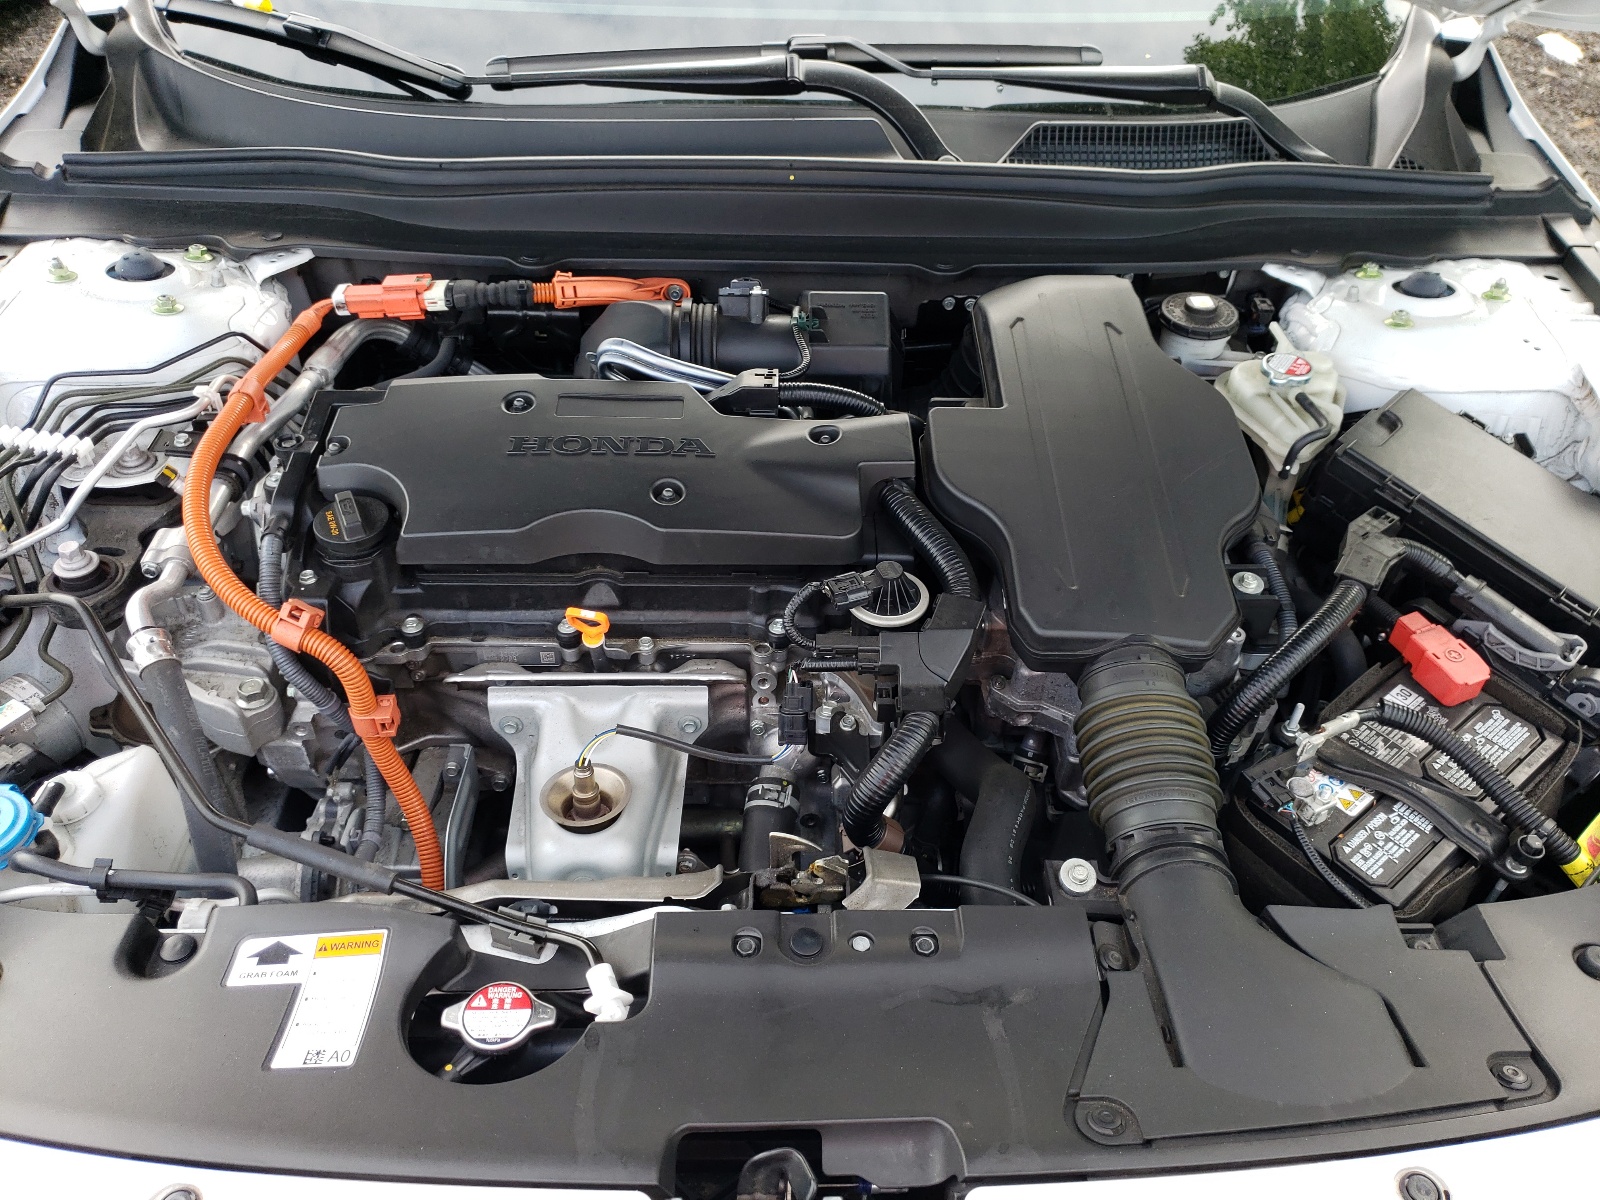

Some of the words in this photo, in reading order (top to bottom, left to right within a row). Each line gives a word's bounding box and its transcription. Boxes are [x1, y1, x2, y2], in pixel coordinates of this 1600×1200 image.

[507, 435, 716, 457] HONDA
[330, 940, 380, 951] WARNING
[487, 991, 524, 999] WARNUNG
[327, 1049, 351, 1063] A0
